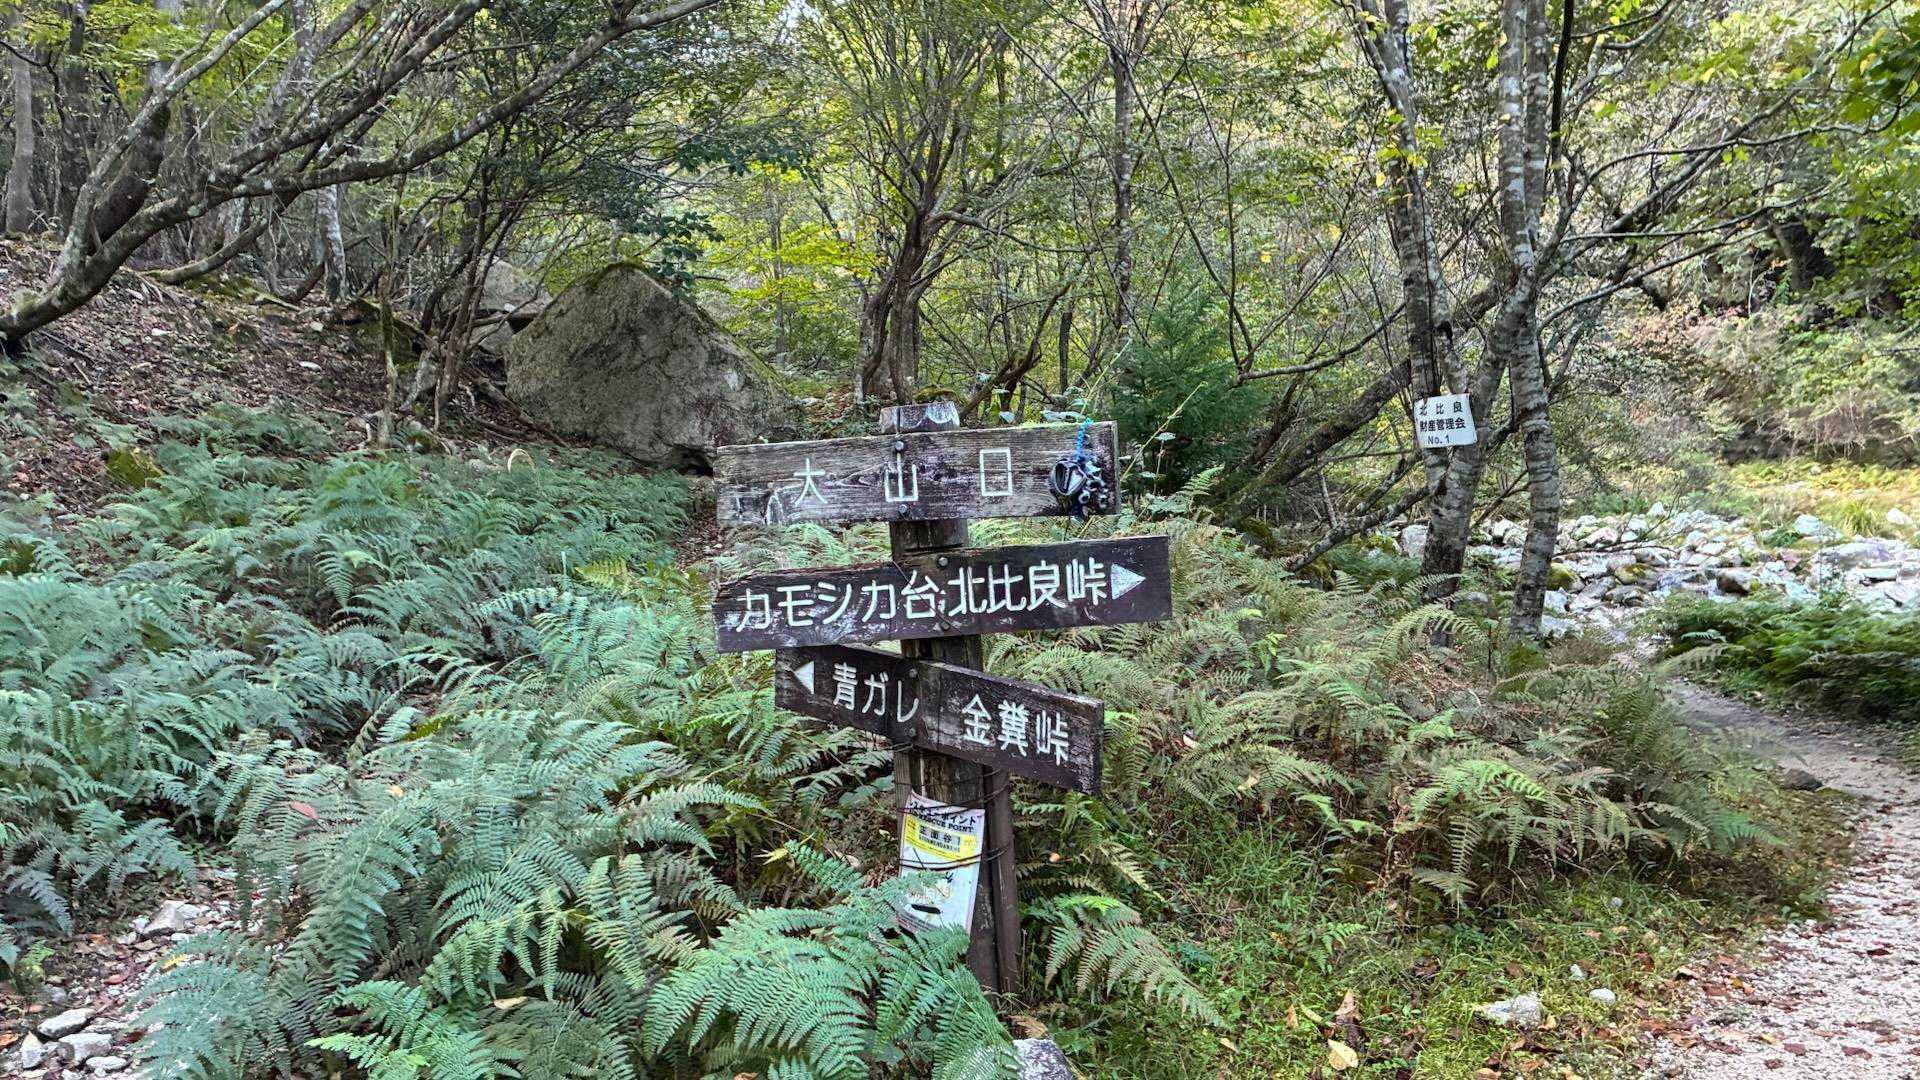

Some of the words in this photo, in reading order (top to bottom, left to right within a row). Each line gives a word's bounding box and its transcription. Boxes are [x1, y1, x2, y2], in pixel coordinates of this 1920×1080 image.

[1419, 401, 1463, 416] 北比良
[1419, 417, 1466, 433] 財産管理会
[832, 662, 919, 723] 青ガレ
[962, 693, 1070, 766] 金糞峠
[948, 822, 975, 833] POINT
